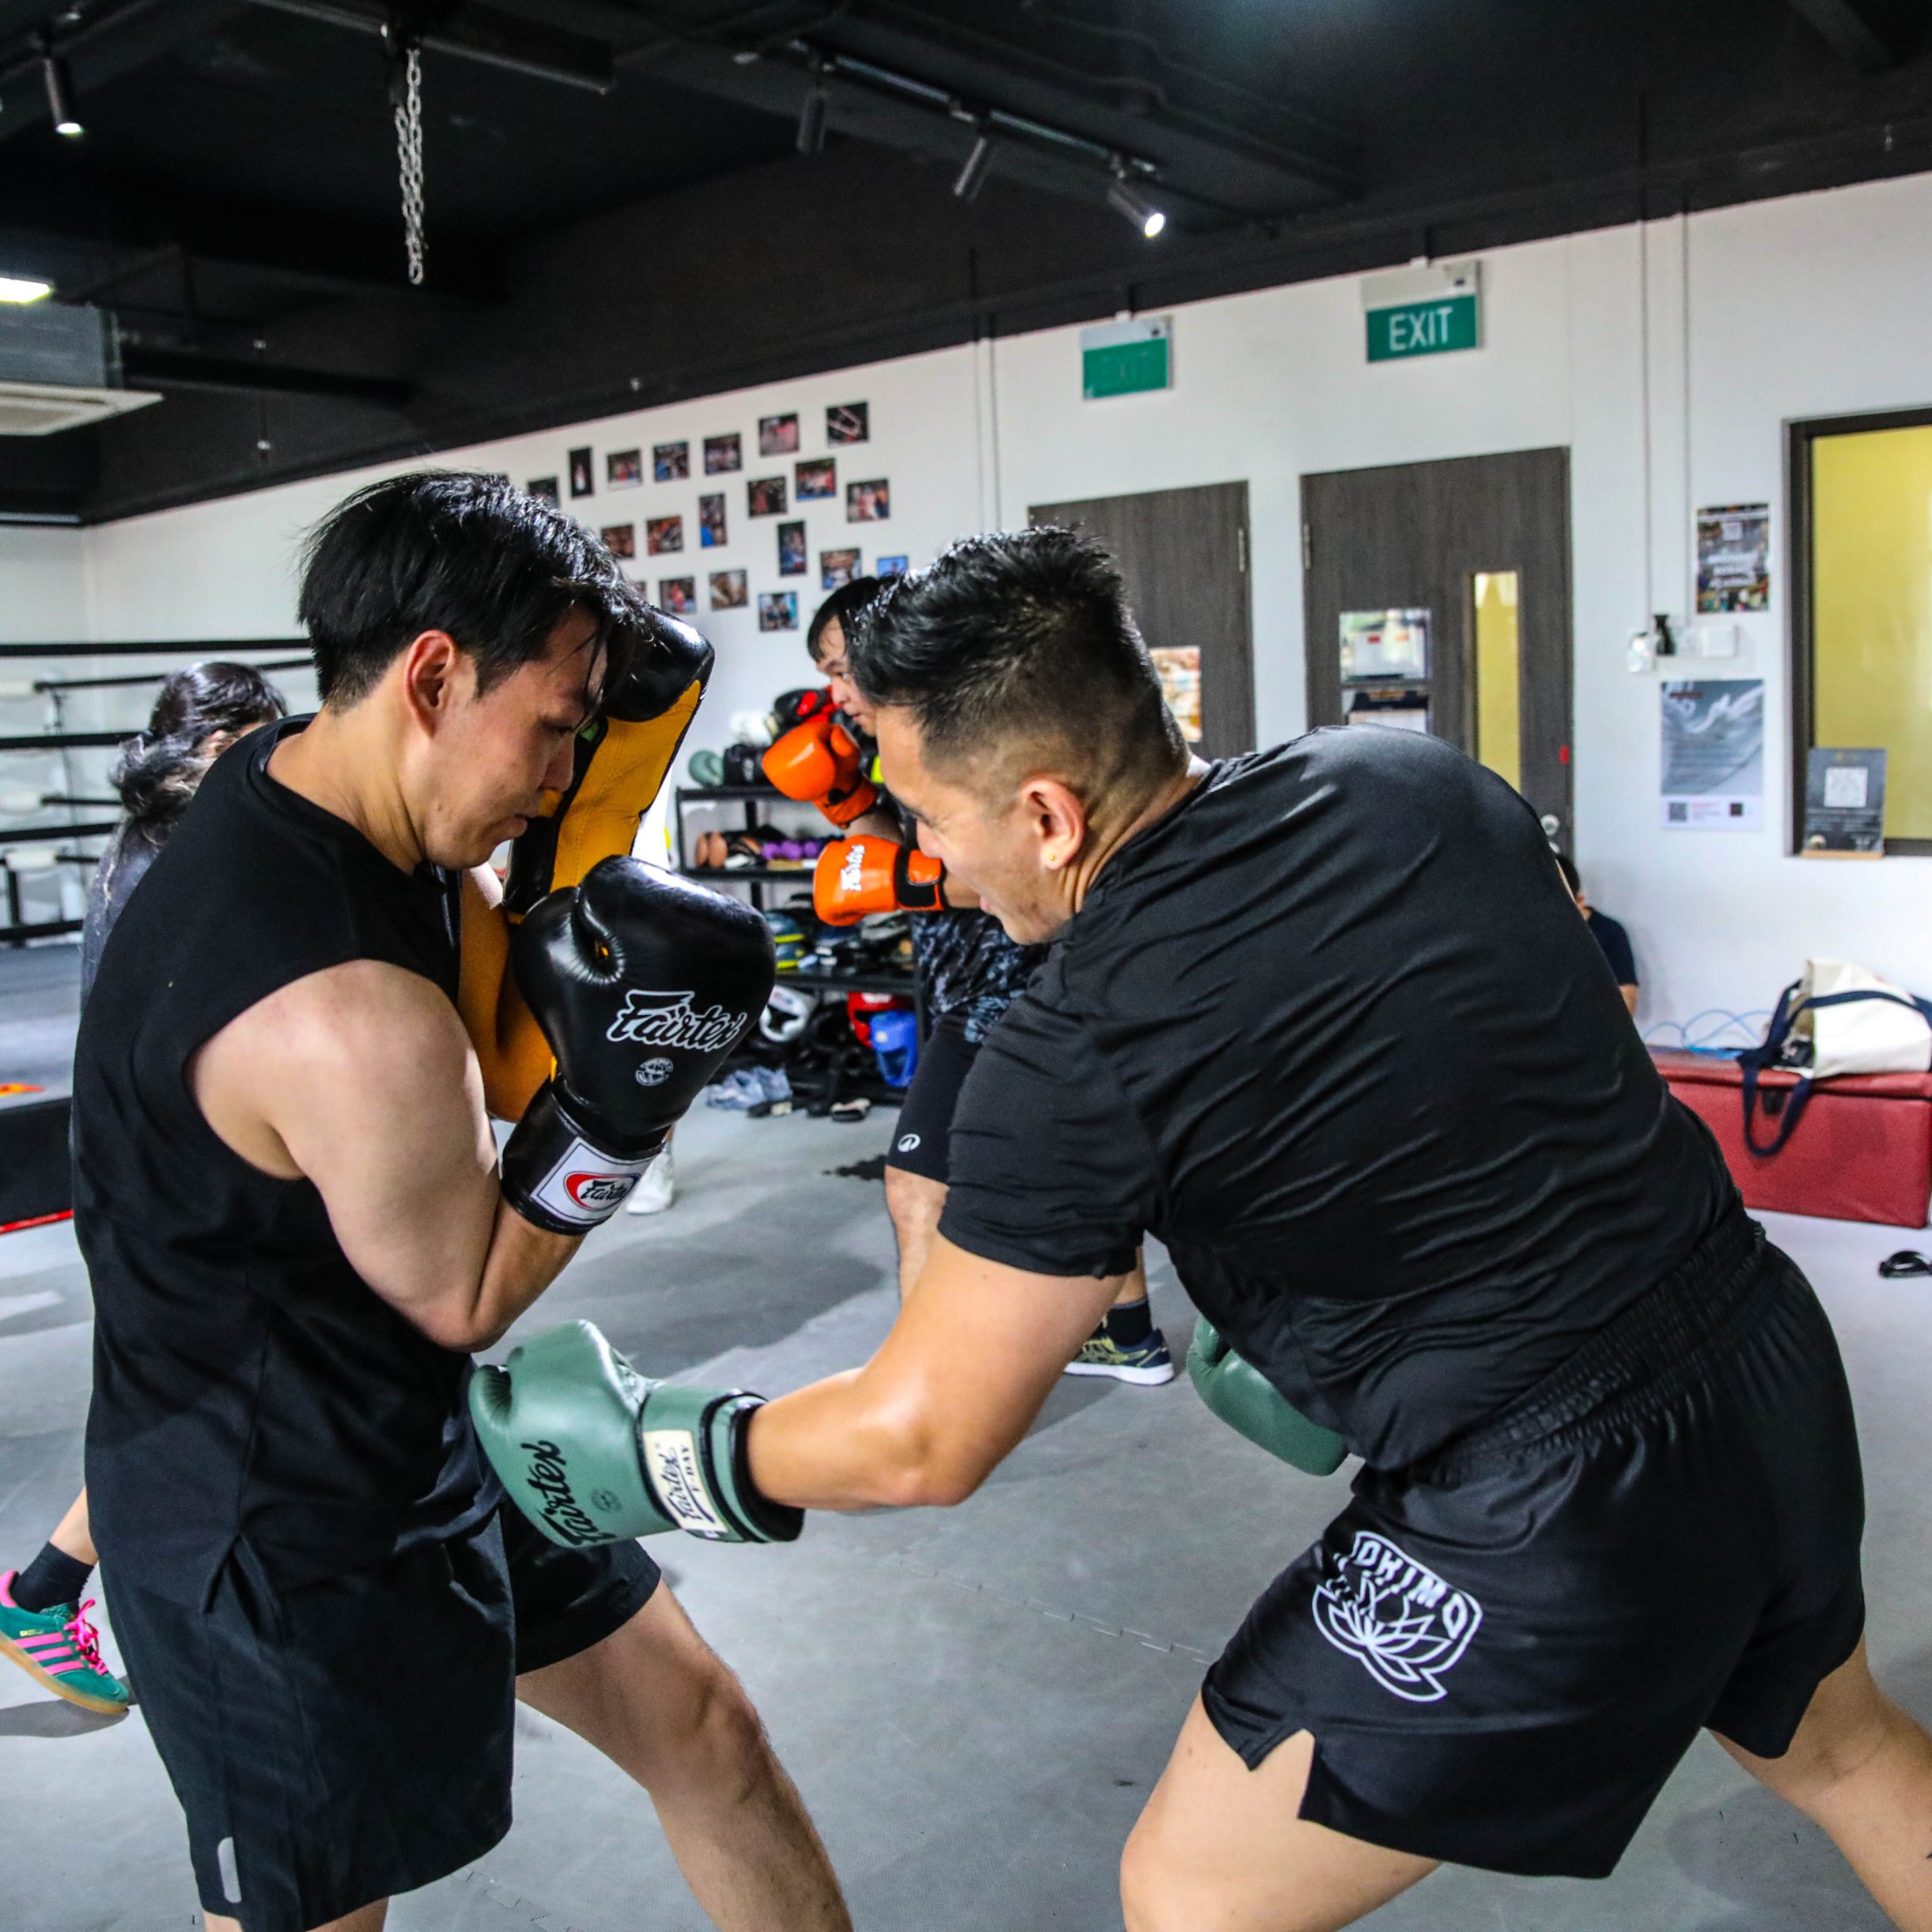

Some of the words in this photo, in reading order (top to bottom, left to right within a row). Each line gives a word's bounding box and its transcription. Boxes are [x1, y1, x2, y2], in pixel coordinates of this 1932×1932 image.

[1389, 306, 1453, 352] EXIT
[606, 998, 747, 1052] Fairtex
[520, 1441, 617, 1545] Fairtex
[658, 1446, 707, 1521] Fairtex
